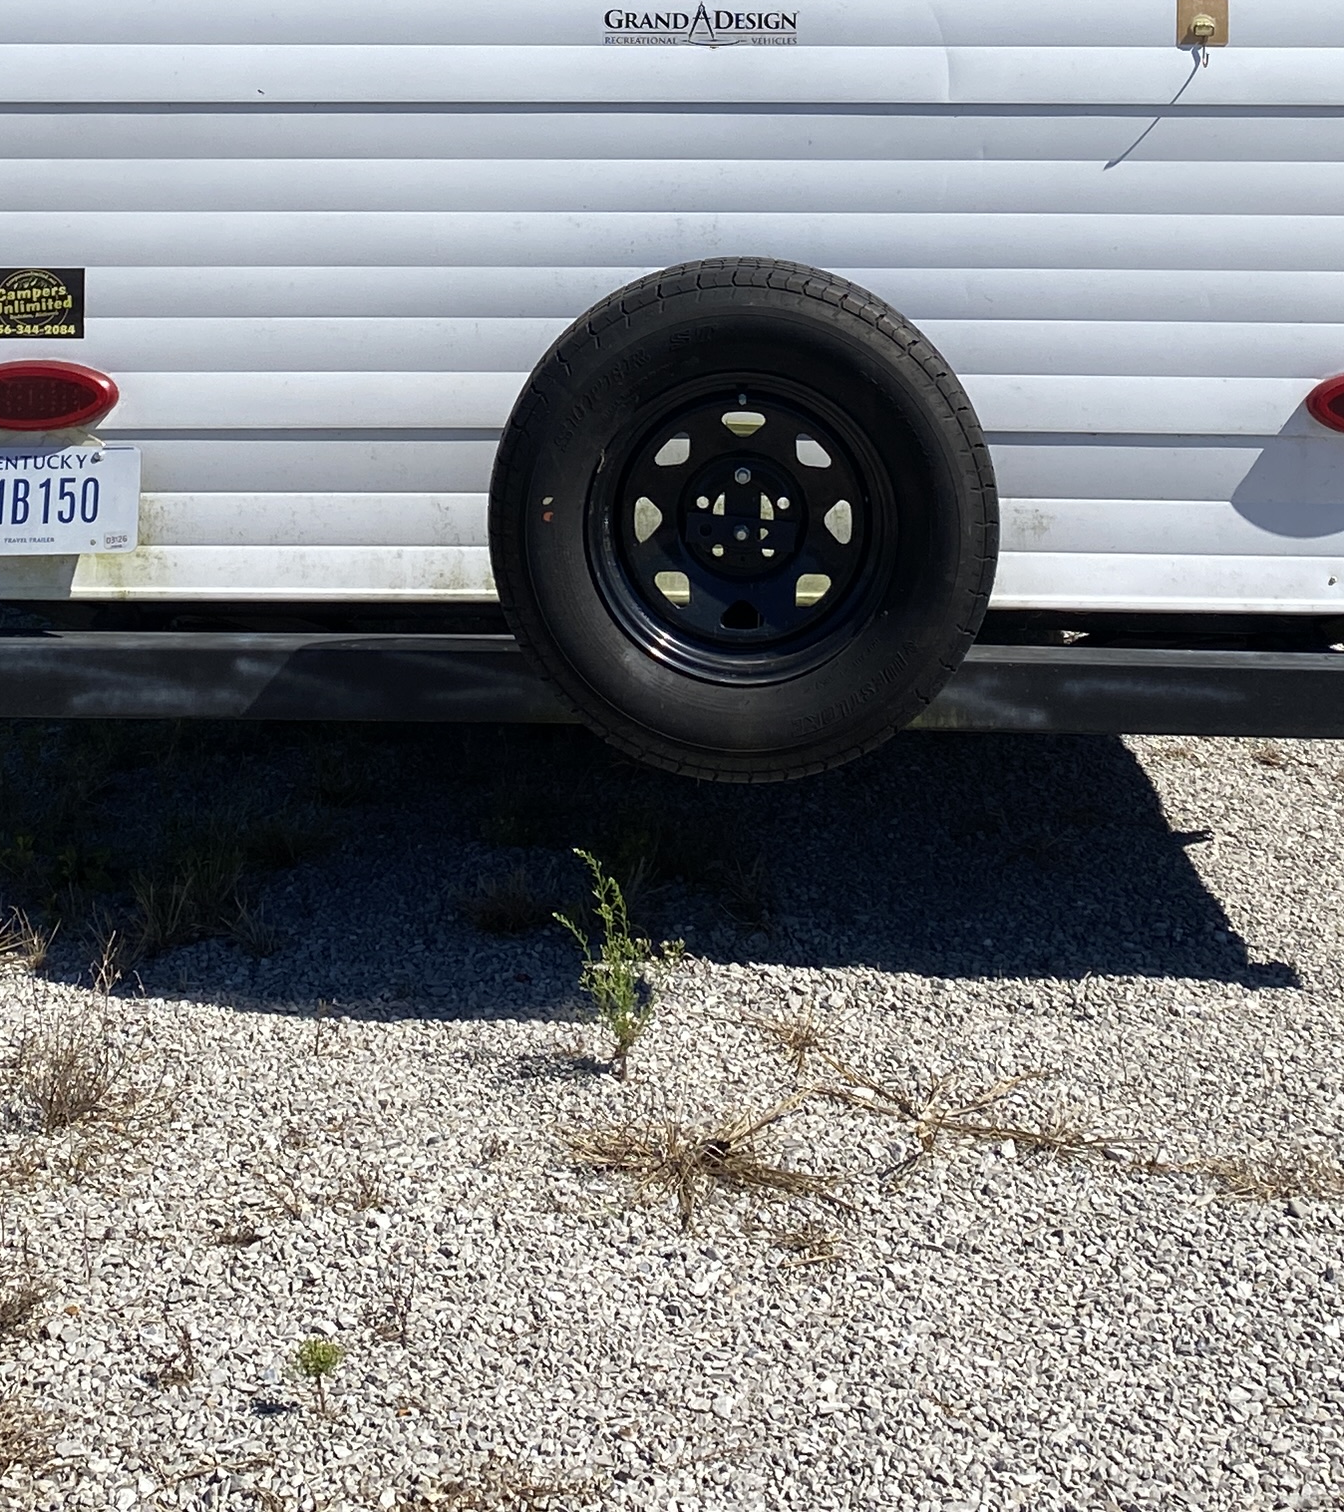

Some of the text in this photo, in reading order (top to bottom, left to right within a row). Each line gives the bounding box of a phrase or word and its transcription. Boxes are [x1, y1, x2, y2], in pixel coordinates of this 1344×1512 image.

[603, 9, 798, 30] GRAND DESIGN
[604, 36, 798, 45] RECREATIONAL VEHICLES
